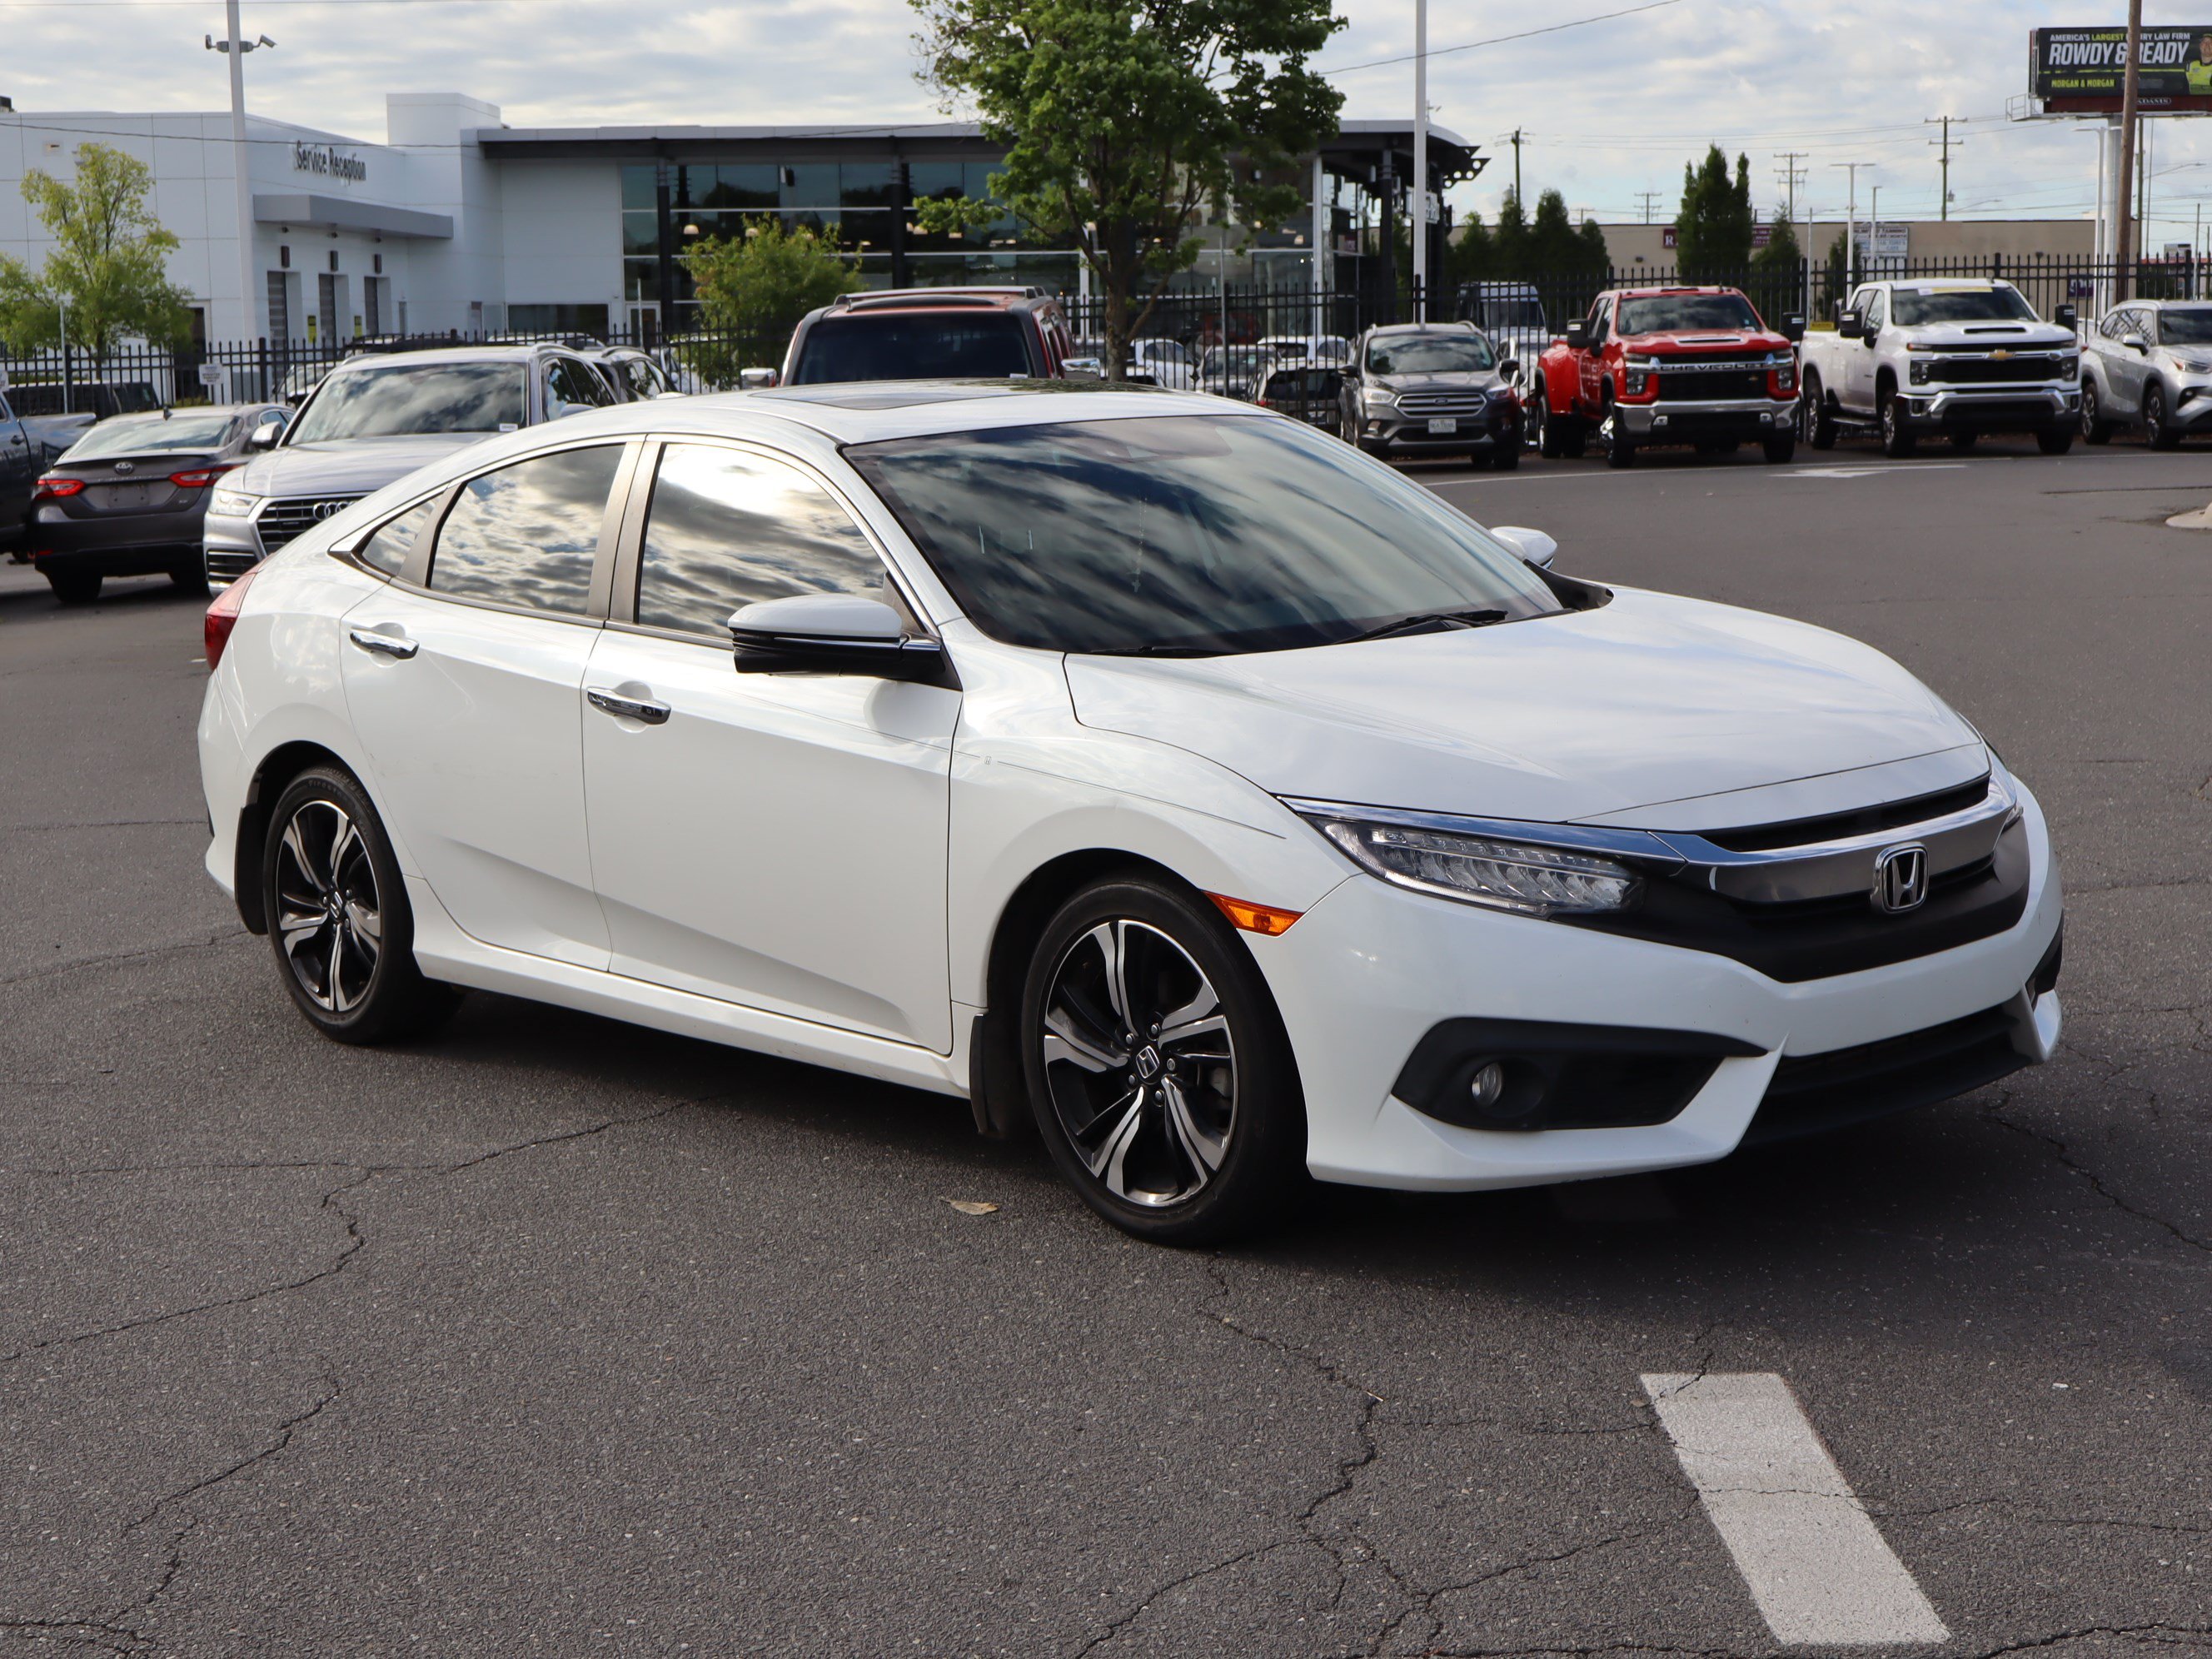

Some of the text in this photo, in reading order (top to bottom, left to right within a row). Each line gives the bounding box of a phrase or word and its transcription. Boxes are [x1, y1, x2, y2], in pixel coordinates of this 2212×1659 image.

[2050, 33, 2090, 42] AMERICA'S
[2091, 32, 2124, 42] LARGEST
[2171, 32, 2190, 40] FIRM
[2049, 42, 2115, 65] ROWDY
[2115, 42, 2128, 65] &
[2051, 78, 2115, 88] MORGAN & MORGAN
[296, 140, 366, 186] Service Reception
[1660, 361, 1766, 371] CHEVROLET
